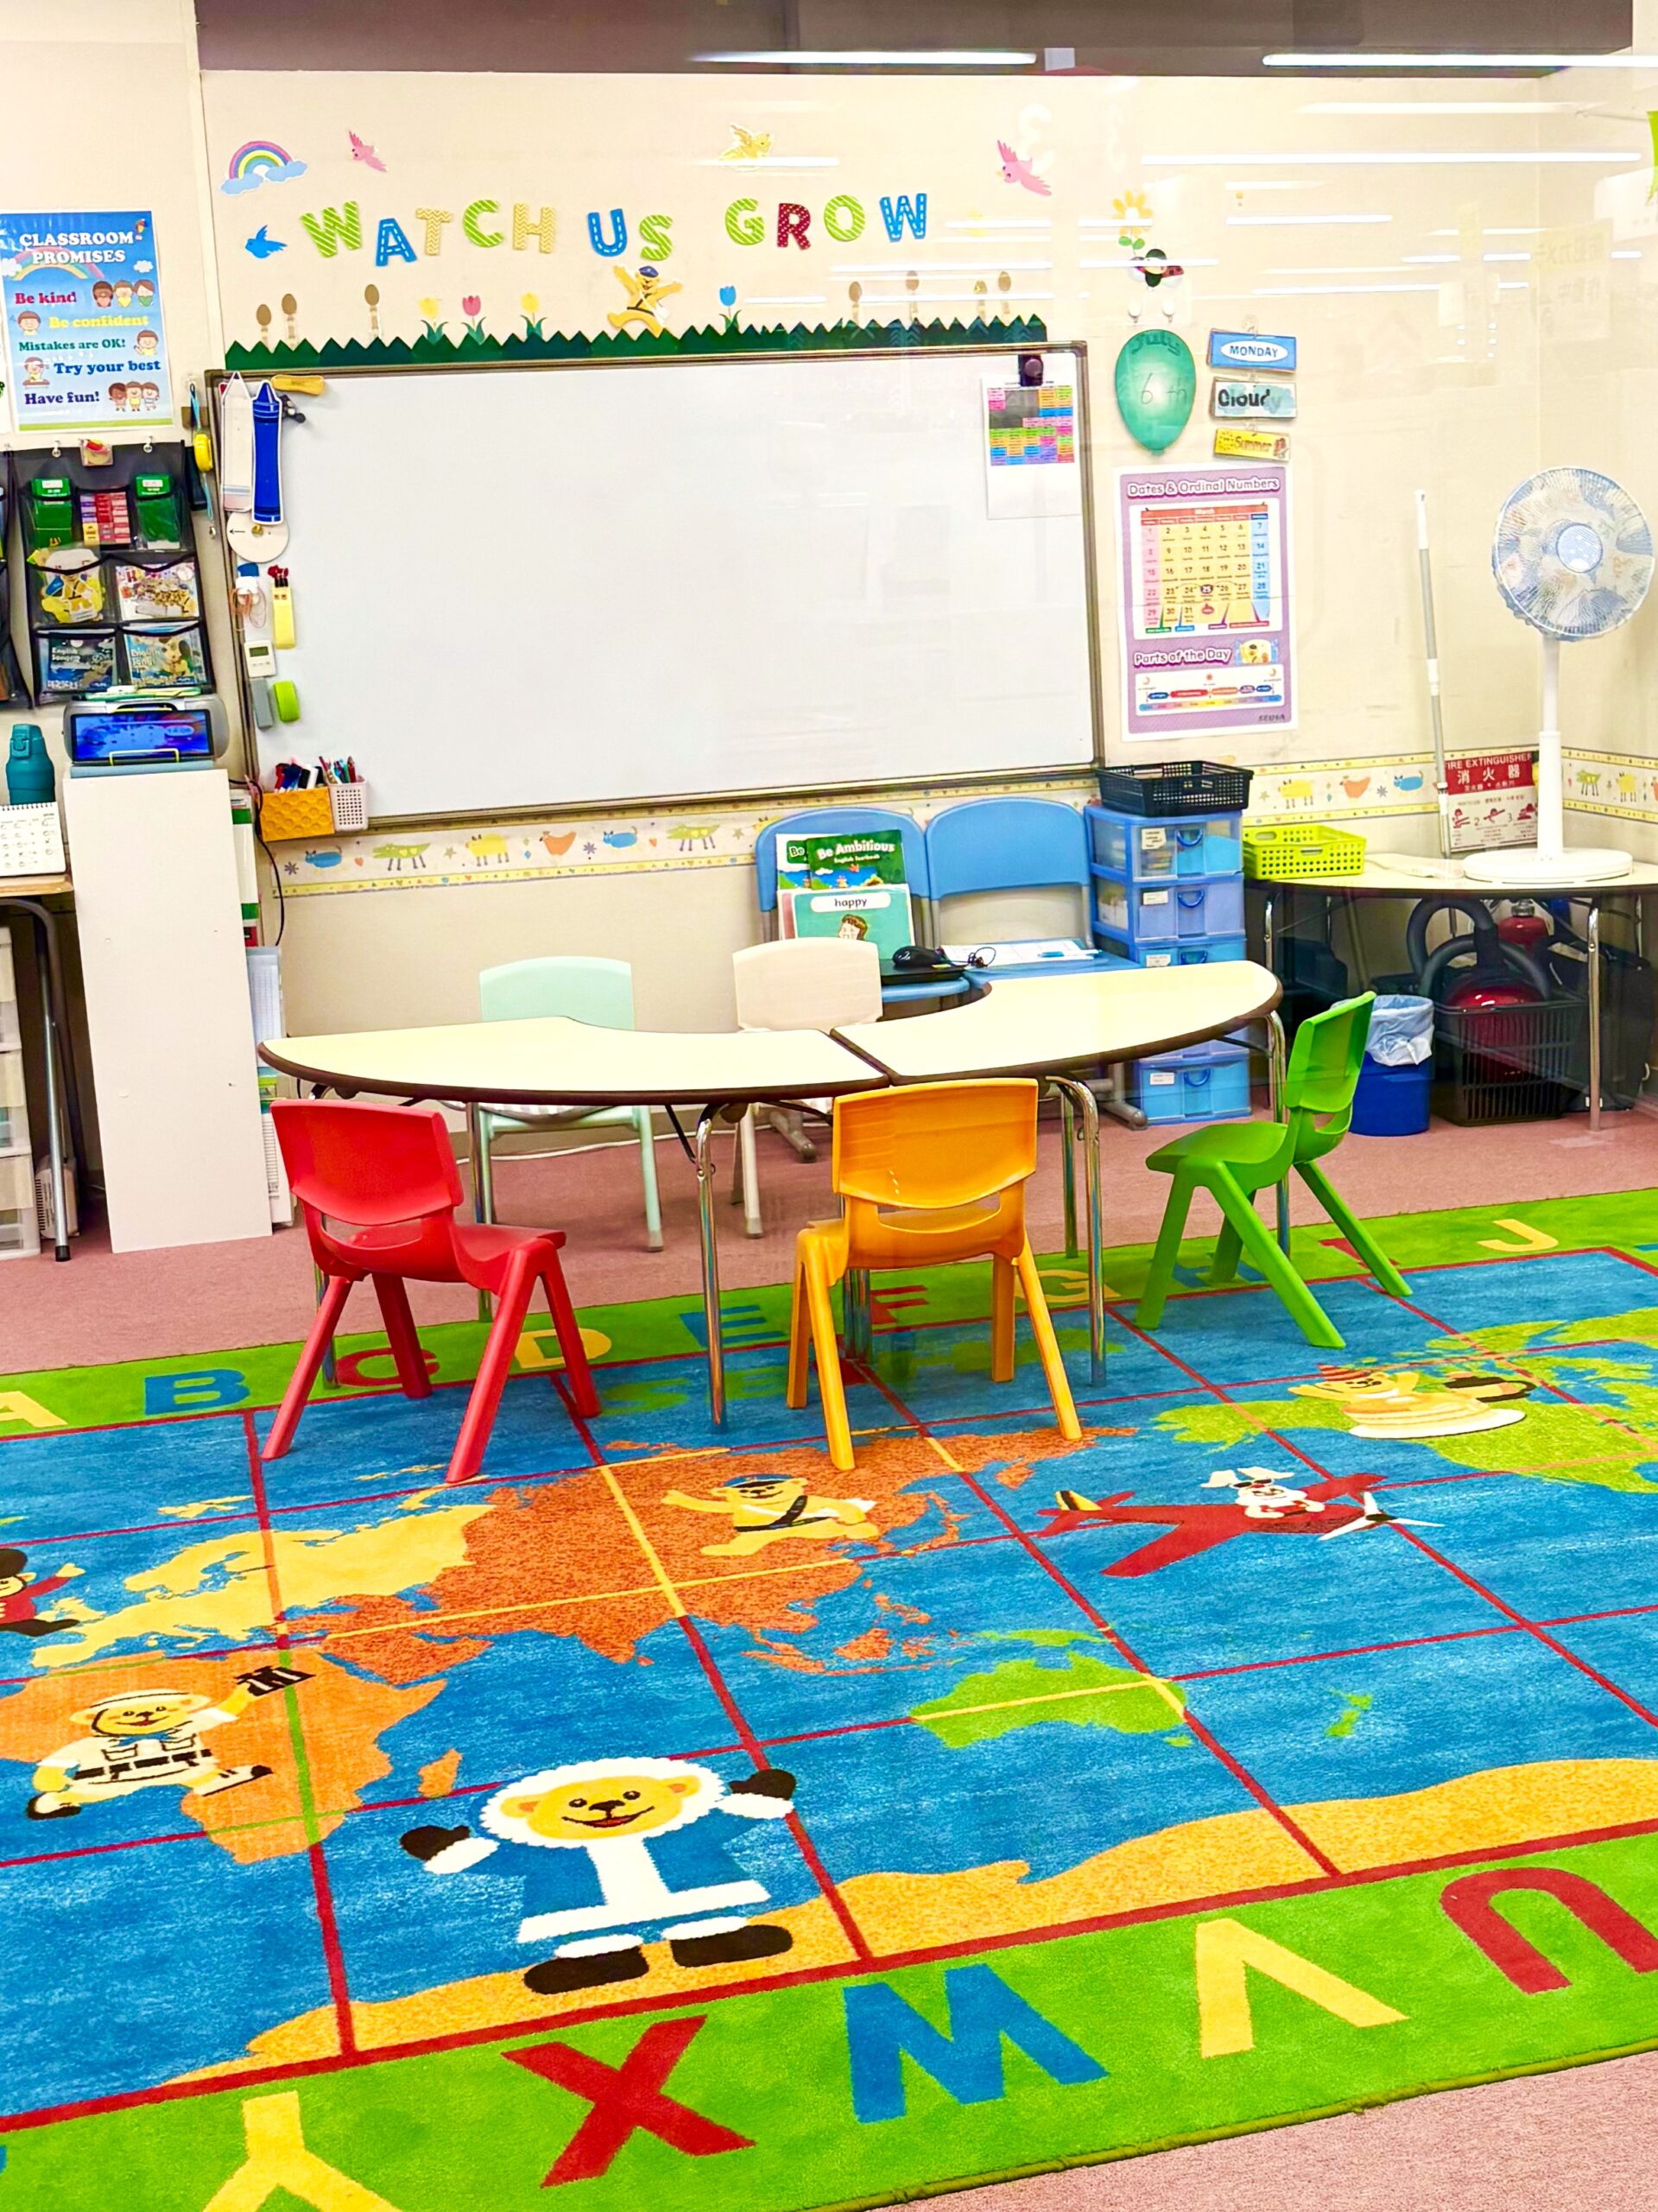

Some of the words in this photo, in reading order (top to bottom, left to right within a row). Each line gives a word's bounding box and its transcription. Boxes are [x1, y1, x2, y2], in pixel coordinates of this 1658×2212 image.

[300, 199, 556, 267] WATCH
[586, 208, 673, 261] US
[725, 193, 927, 250] GROW
[19, 231, 134, 247] CLASSROOM
[32, 250, 126, 265] PROMISES
[15, 292, 35, 304] Be
[48, 317, 69, 329] Be
[18, 340, 76, 352] Mistakes
[79, 341, 98, 350] are
[102, 338, 126, 350] OK!
[1229, 345, 1278, 358] MONDAY
[54, 362, 84, 376] Try
[87, 364, 124, 375] your
[129, 360, 161, 371] best
[24, 392, 64, 405] Have
[67, 391, 100, 404] fun!
[1129, 483, 1164, 496] Dates
[1167, 483, 1175, 492] &
[1179, 479, 1225, 492] Ordinal
[1227, 478, 1279, 490] Numbers
[1135, 653, 1167, 664] Parts
[1169, 651, 1182, 662] of
[1185, 650, 1204, 662] the
[1207, 648, 1231, 662] Day
[816, 848, 834, 860] Be
[835, 839, 895, 856] Ambitious
[834, 897, 867, 909] happy
[145, 1369, 250, 1416] B
[518, 1328, 611, 1369] D
[1478, 1219, 1559, 1253] J
[1196, 1917, 1409, 2059] V
[501, 2014, 756, 2188] X
[201, 2090, 403, 2212] Y
